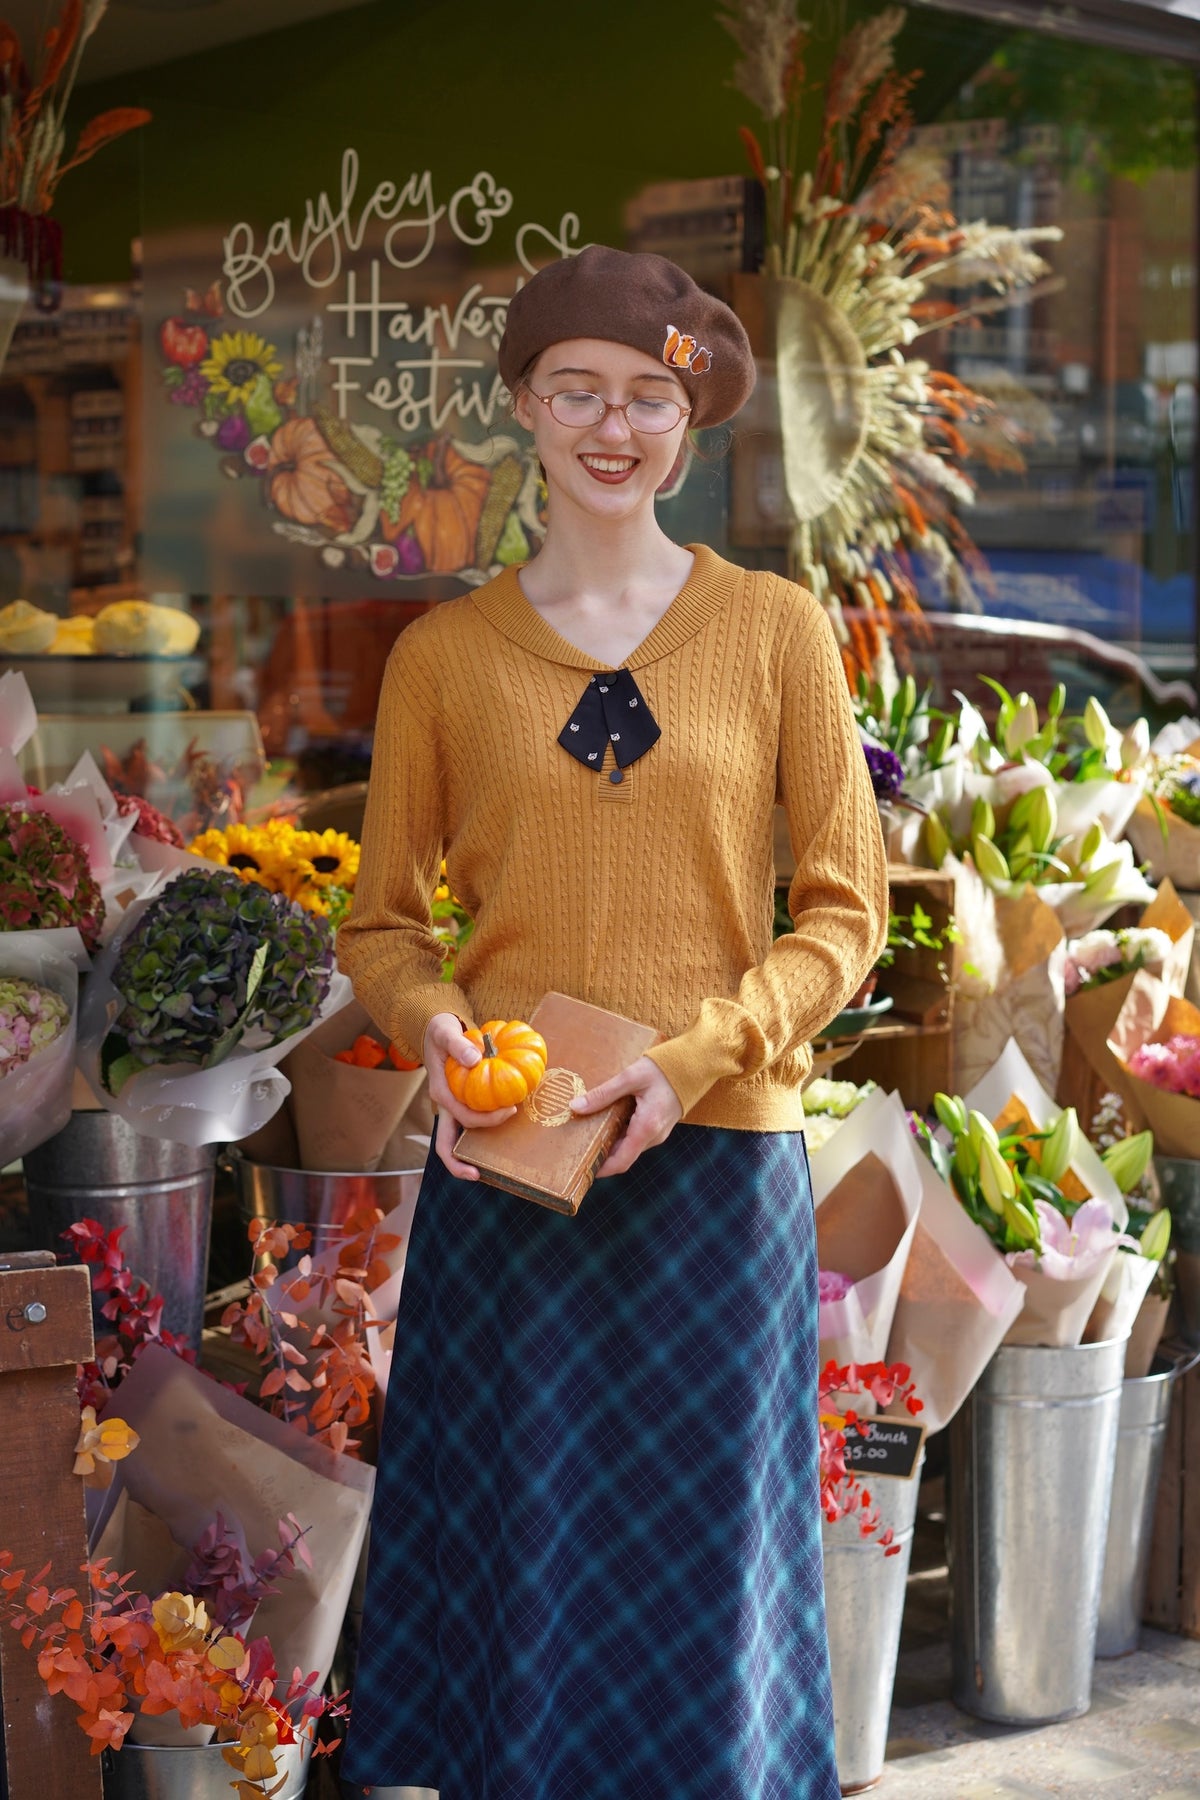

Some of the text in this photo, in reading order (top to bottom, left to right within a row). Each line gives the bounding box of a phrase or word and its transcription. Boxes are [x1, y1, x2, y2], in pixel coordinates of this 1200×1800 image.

[224, 148, 446, 318] Bayley
[449, 171, 513, 246] &
[326, 259, 525, 359] Harves
